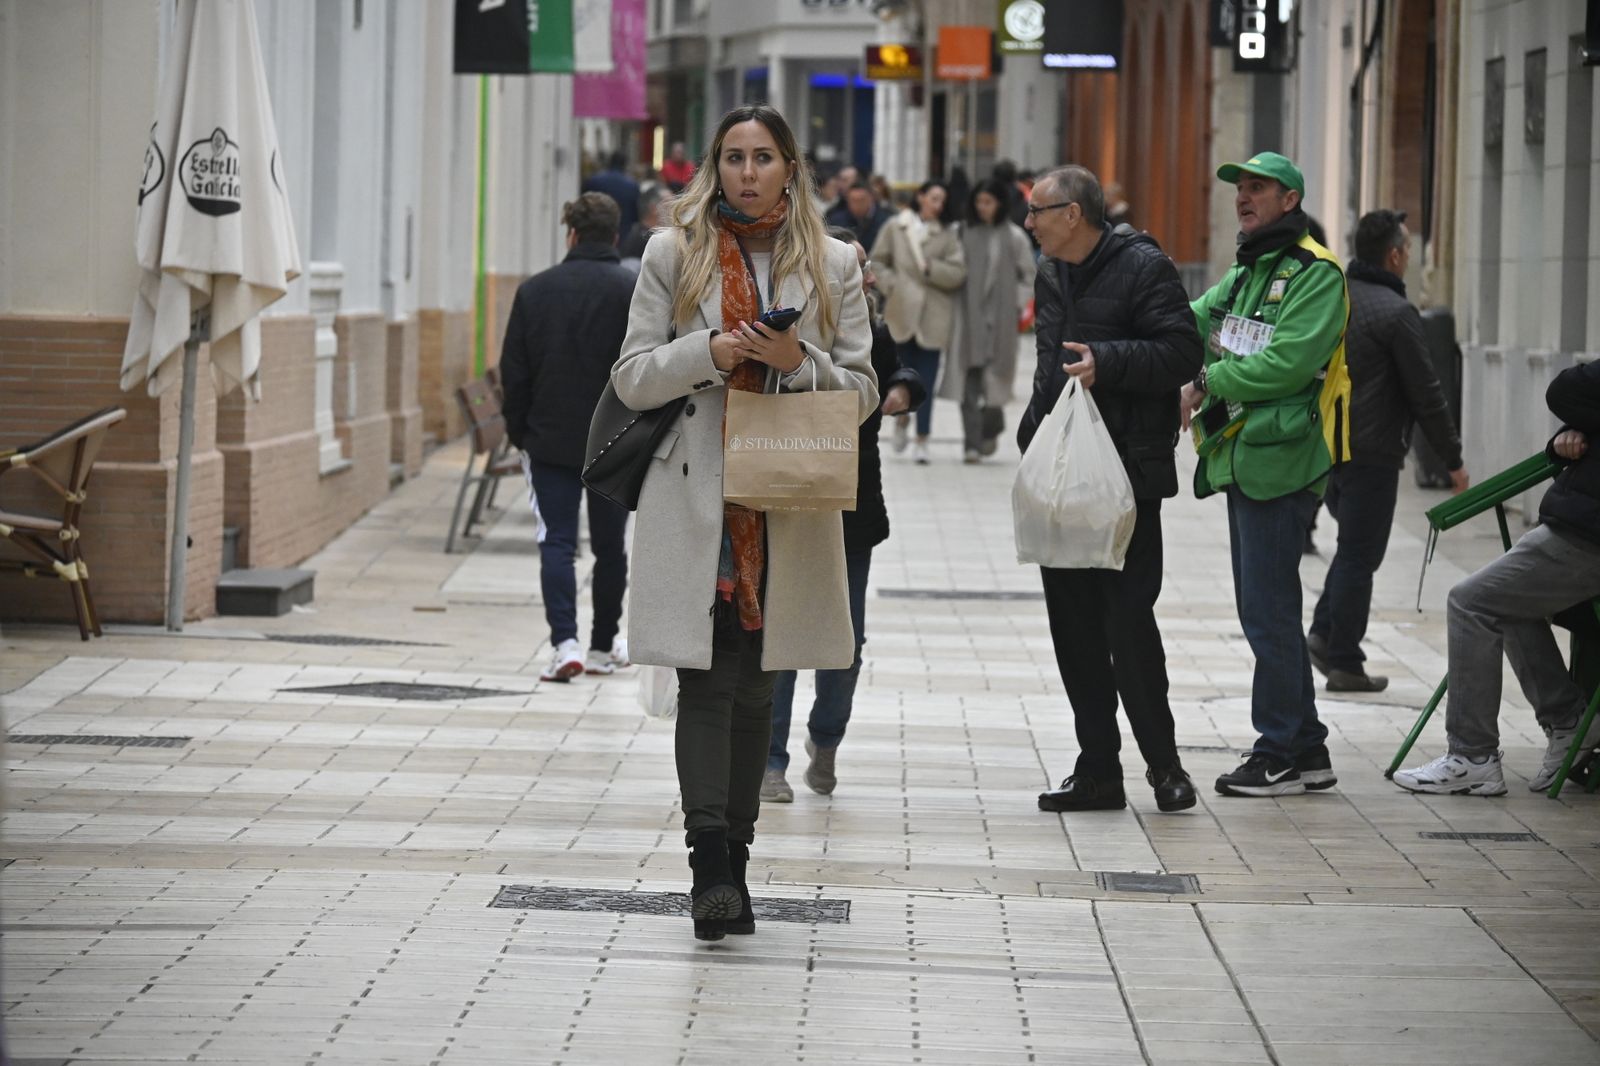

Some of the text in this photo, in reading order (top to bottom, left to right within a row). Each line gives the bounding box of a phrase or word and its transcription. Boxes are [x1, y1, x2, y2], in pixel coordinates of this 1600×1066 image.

[190, 151, 240, 176] Estrell
[191, 173, 241, 198] Galcia
[744, 436, 852, 450] STRADIVARIUS
